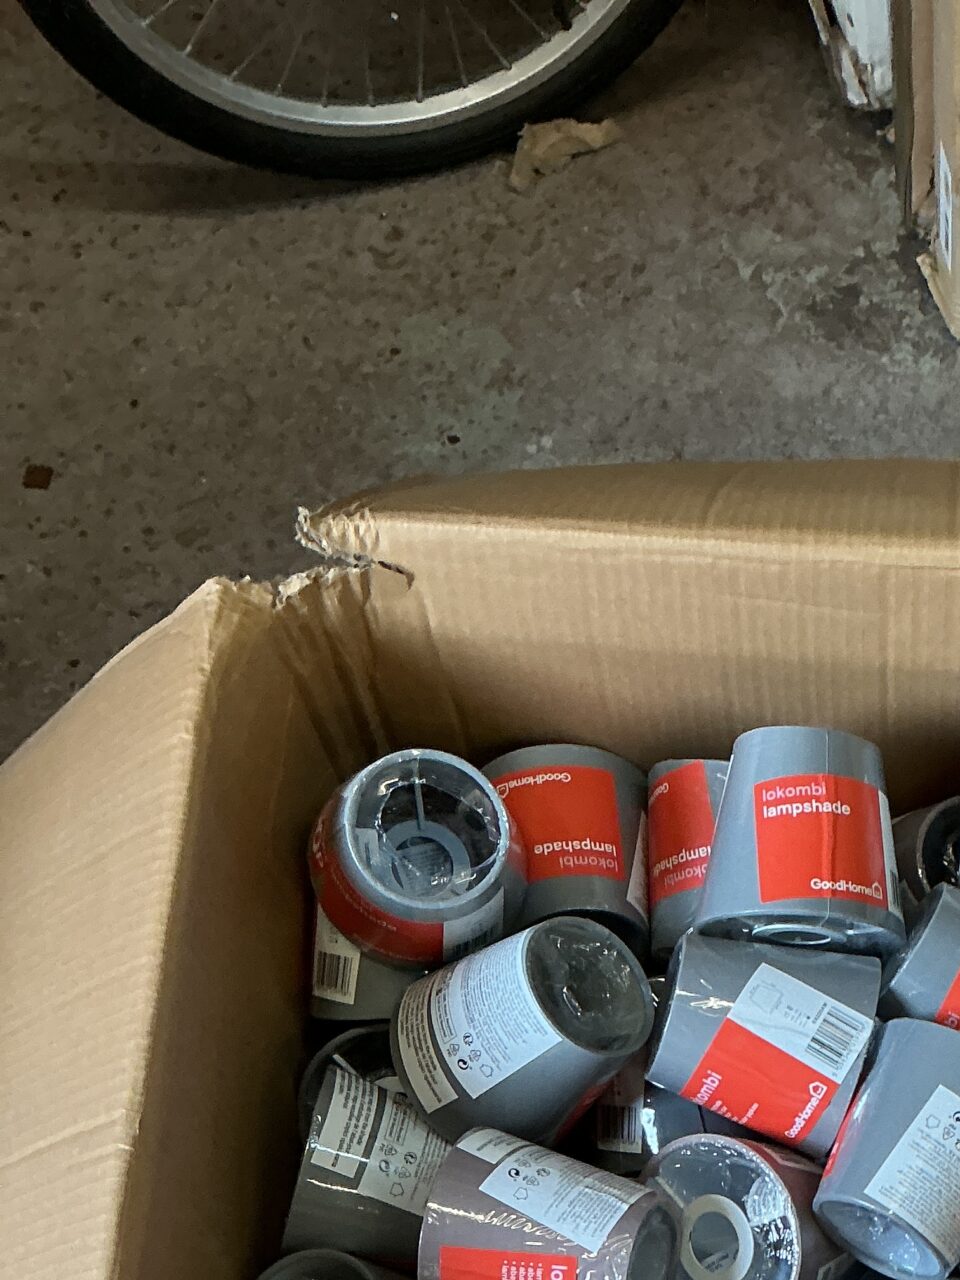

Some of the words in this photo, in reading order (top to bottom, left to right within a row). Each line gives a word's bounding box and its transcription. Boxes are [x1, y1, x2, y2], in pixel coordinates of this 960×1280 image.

[507, 771, 571, 794] GoodHome
[762, 782, 827, 802] lokombi
[762, 798, 851, 819] lampshade
[533, 837, 618, 857] lampshade
[558, 856, 619, 873] lokombi
[810, 877, 874, 898] GoodHome
[784, 1096, 820, 1138] GoodHome
